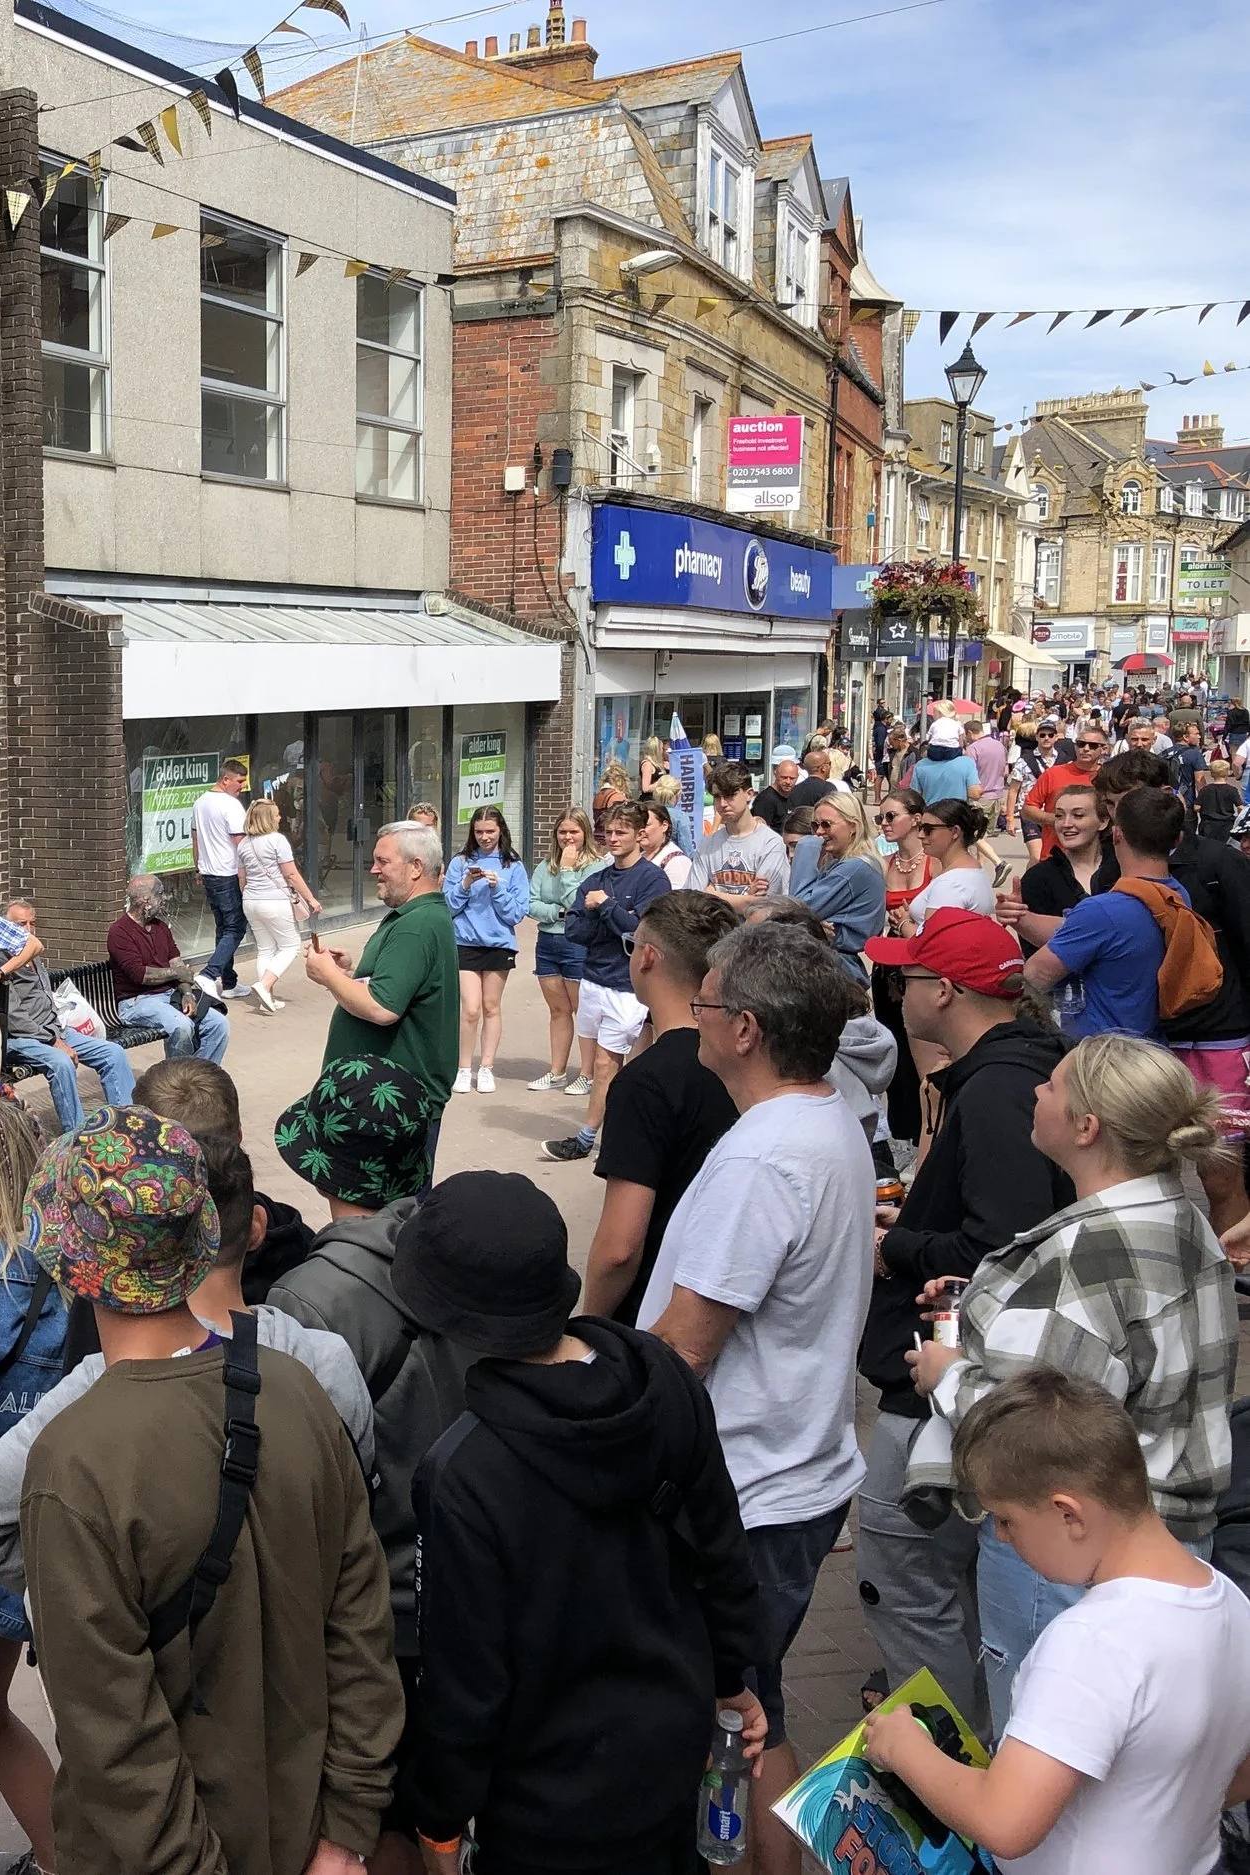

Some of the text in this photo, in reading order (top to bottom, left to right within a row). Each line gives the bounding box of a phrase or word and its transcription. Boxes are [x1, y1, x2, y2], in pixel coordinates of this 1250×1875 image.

[732, 421, 784, 433] auction
[732, 467, 793, 476] 020 7543 6800
[754, 490, 794, 506] allsop
[675, 542, 723, 585] pharmacy
[790, 565, 811, 599] beauty
[1204, 580, 1224, 588] LET
[156, 758, 209, 783] alder king
[468, 780, 500, 800] TO LET
[156, 819, 176, 843] TO
[719, 1810, 731, 1841] smart
